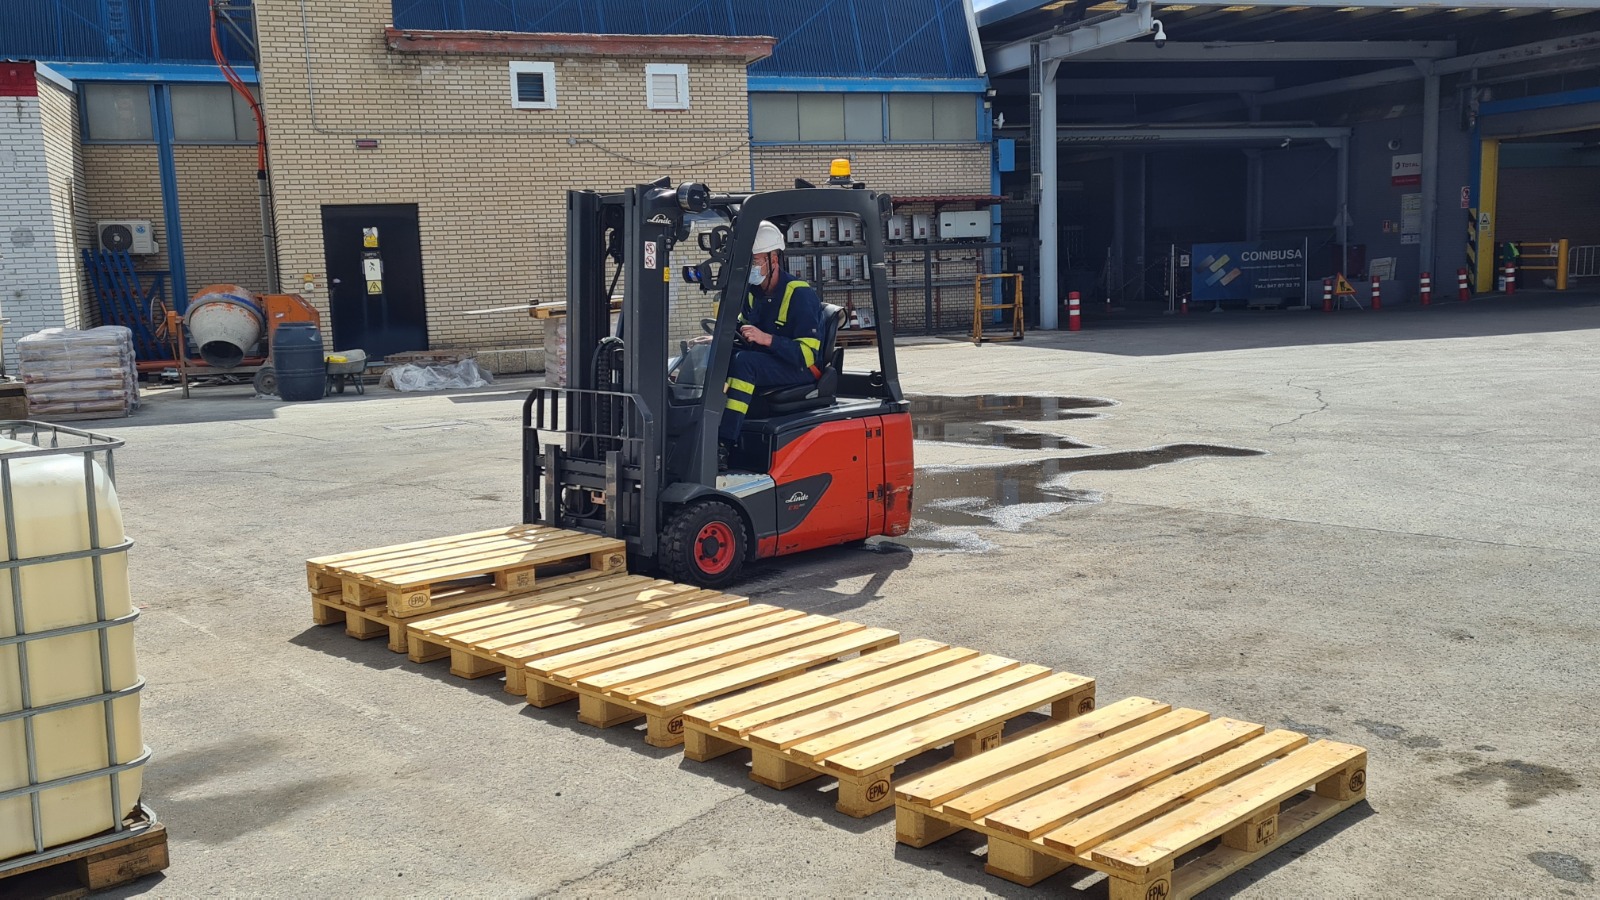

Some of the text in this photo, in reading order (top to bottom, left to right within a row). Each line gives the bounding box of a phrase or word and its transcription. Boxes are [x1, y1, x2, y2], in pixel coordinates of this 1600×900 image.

[646, 213, 671, 225] Linde
[1241, 249, 1303, 261] COINBUSA
[785, 491, 809, 503] Linde
[410, 595, 424, 605] EPAL
[671, 718, 684, 731] EPA
[869, 783, 886, 800] EPAL
[1149, 883, 1165, 900] EPAL
